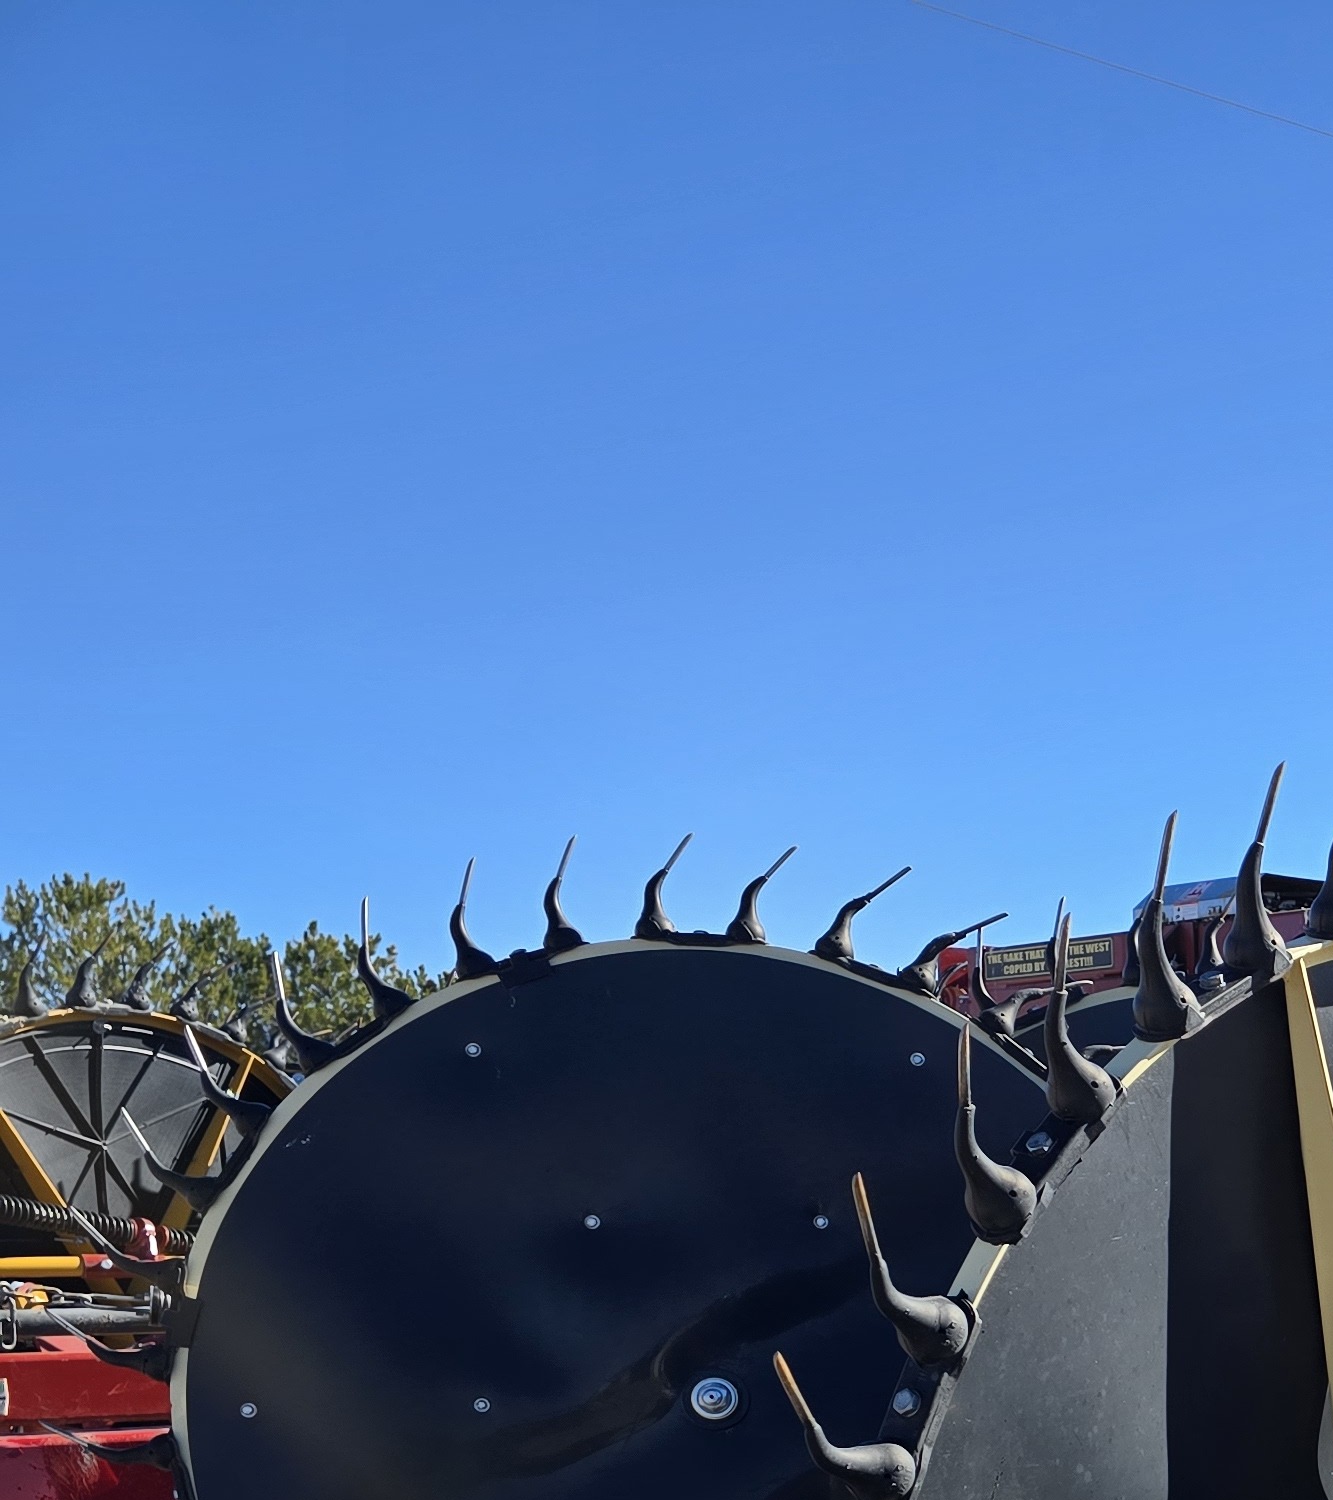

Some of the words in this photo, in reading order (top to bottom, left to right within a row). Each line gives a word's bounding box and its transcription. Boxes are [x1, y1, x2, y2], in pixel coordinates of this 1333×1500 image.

[987, 955, 1002, 964] THE
[1003, 952, 1024, 962] RAKE
[1026, 949, 1045, 960] THAT
[1069, 945, 1084, 955] THE
[1085, 942, 1109, 953] WEST
[1004, 963, 1033, 975] COPIED
[1035, 962, 1045, 971] BY
